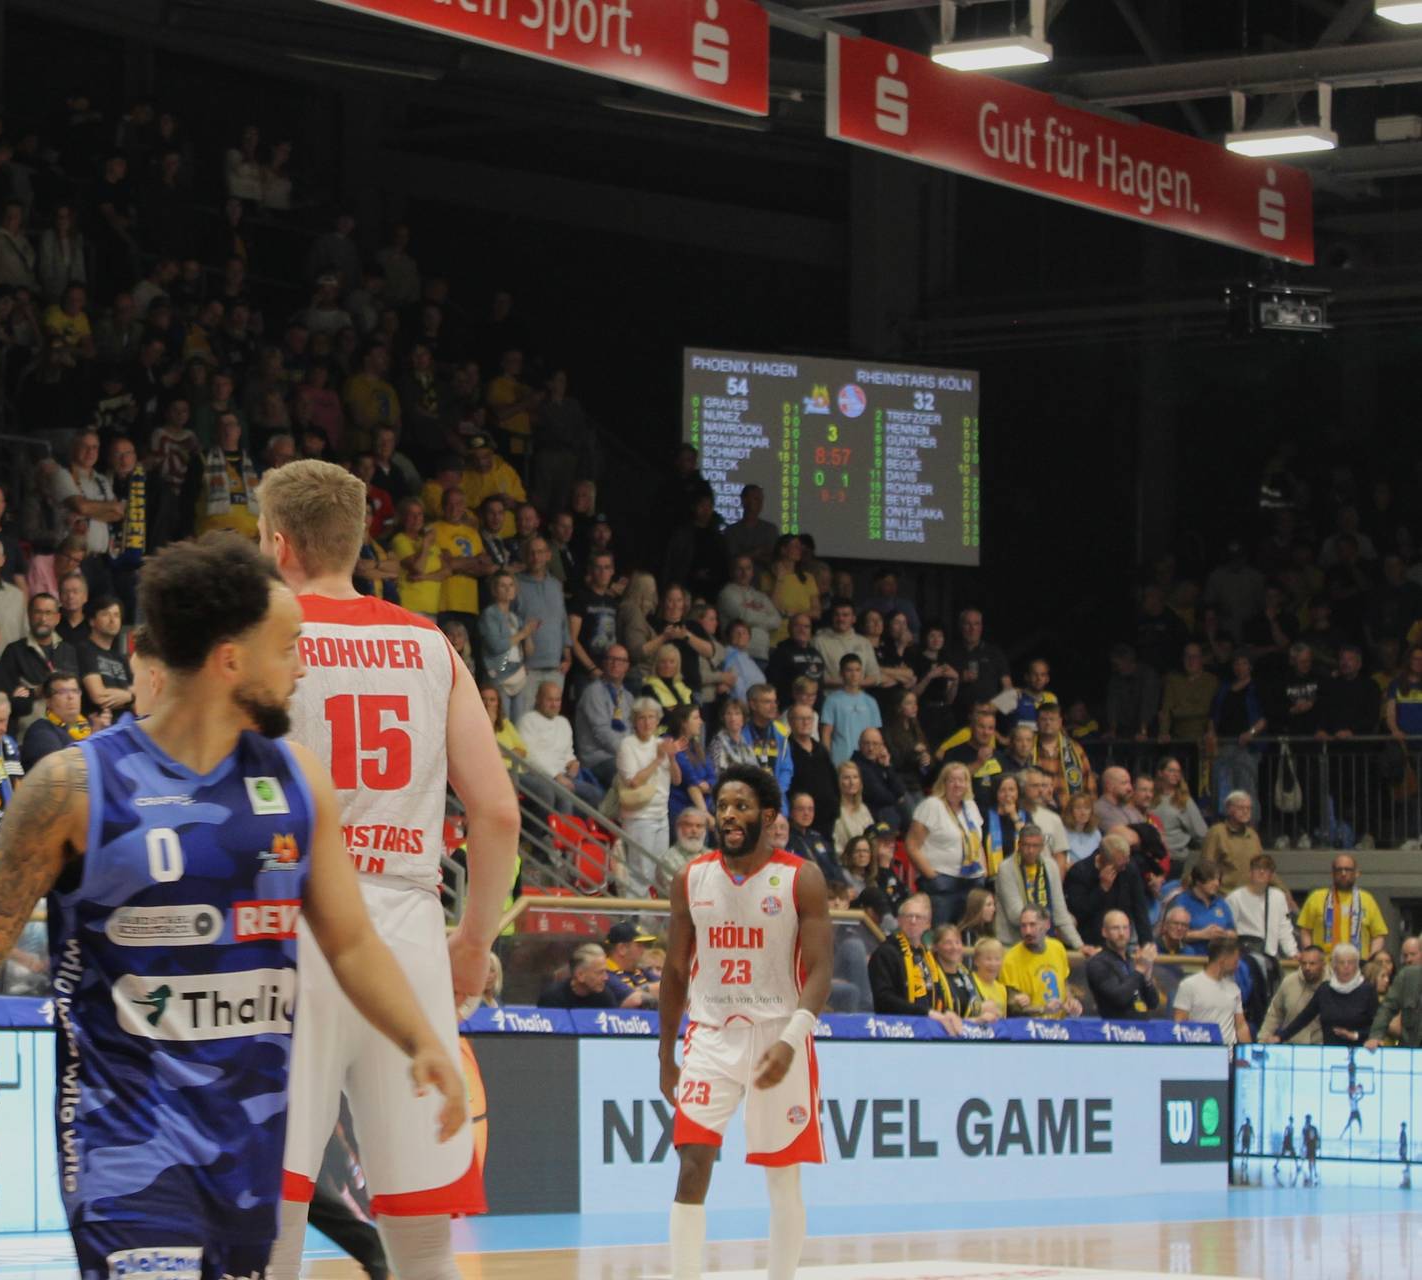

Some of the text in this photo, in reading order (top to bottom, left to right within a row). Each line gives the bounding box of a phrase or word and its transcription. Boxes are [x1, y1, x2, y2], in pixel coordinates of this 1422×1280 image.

[979, 102, 1200, 214] Gut für Hagen.
[692, 356, 798, 377] PHOENIX HAGEN
[727, 377, 749, 396] 54
[856, 369, 972, 392] RHEINSTARS KÖLN
[704, 397, 749, 411] GRAVES
[913, 392, 935, 411] 32
[703, 422, 762, 436] NAWROCKI
[827, 423, 838, 442] 3
[703, 434, 770, 448] KRAUSHAAR
[703, 446, 752, 460] SCHMIDT
[703, 458, 739, 471] BLECK
[702, 470, 727, 481] VON
[814, 469, 825, 487] 0
[886, 471, 919, 483] DAVIS
[886, 483, 934, 496] ROHWER
[886, 518, 923, 531] MILLER
[297, 636, 424, 670] ROHWER
[324, 694, 412, 791] 15
[145, 827, 185, 883] 0
[236, 904, 301, 936] REW
[708, 920, 765, 949] KÖLN
[720, 959, 753, 985] 23
[505, 1011, 553, 1033] Thalia
[608, 1014, 651, 1034] Thalia
[877, 1020, 915, 1039] Thalia
[1035, 1023, 1070, 1041] Thalia
[1110, 1023, 1146, 1042] Thalia
[1180, 1024, 1212, 1043] Thalia
[59, 1062, 82, 1124] wilo
[680, 1079, 712, 1106] 23
[602, 1097, 1113, 1164] NX VEL GAME
[62, 1129, 82, 1194] wilo
